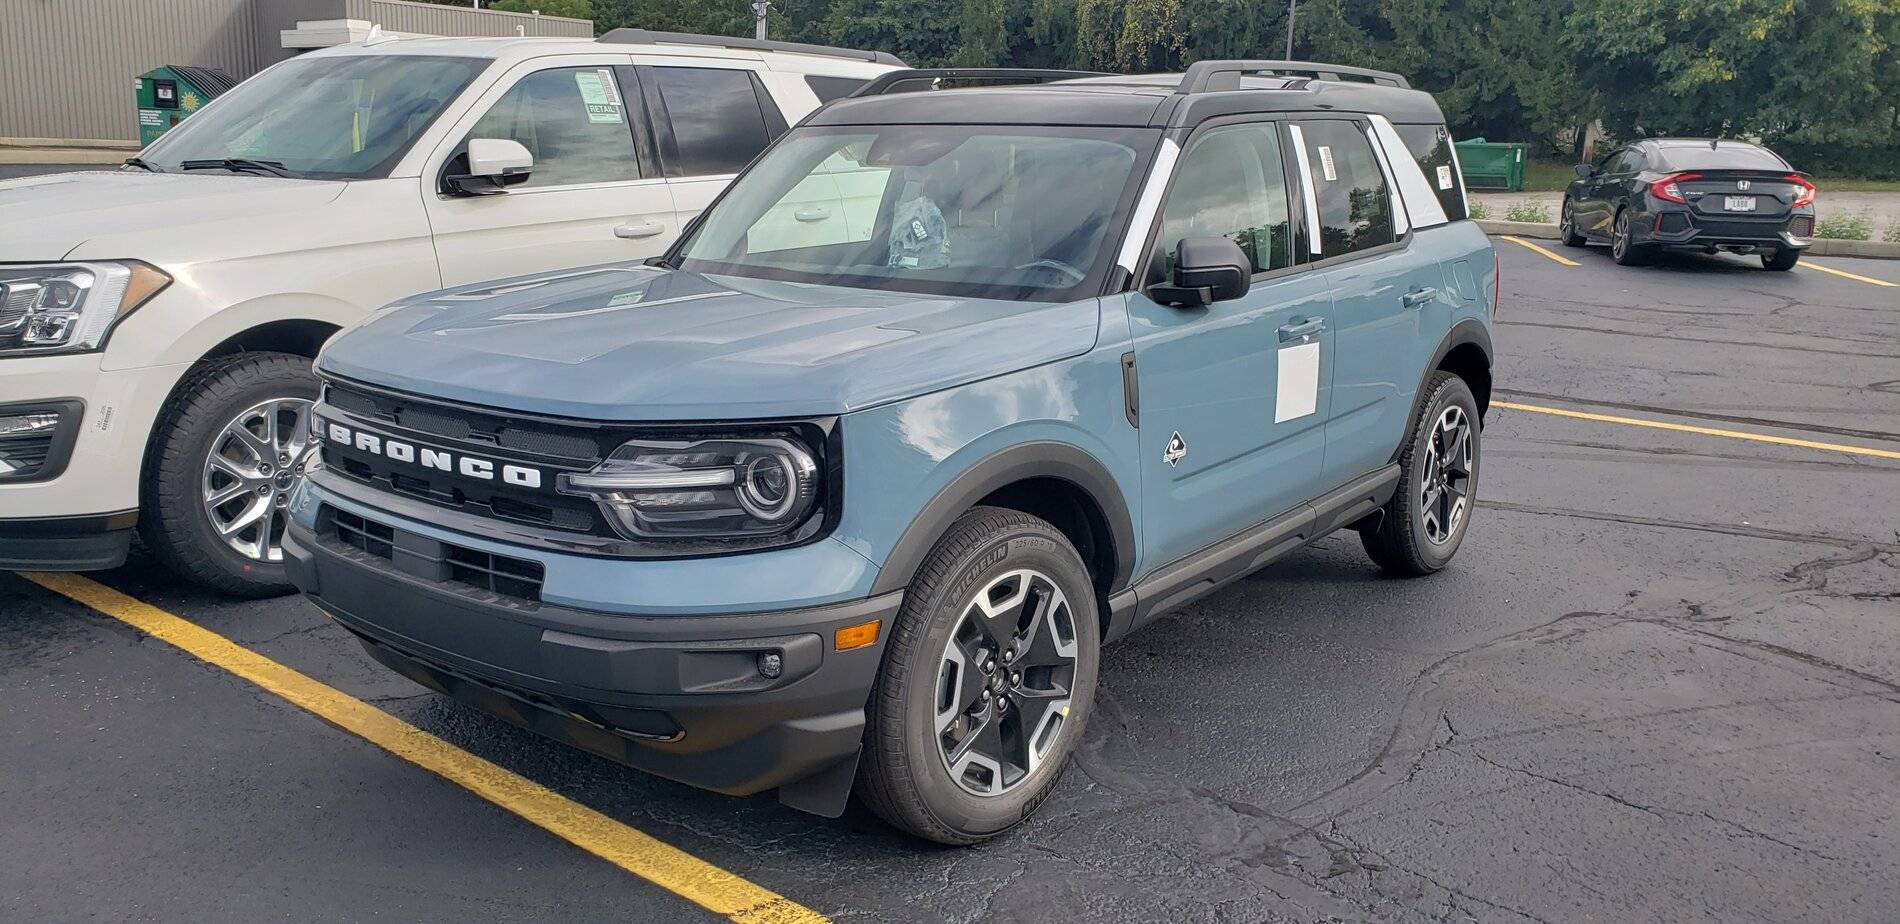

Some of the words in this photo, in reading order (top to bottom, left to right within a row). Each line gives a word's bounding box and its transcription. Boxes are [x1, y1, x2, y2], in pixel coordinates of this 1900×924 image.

[590, 105, 616, 113] RETAIL
[329, 423, 541, 488] BRONCO
[951, 545, 1006, 605] MICHELIN
